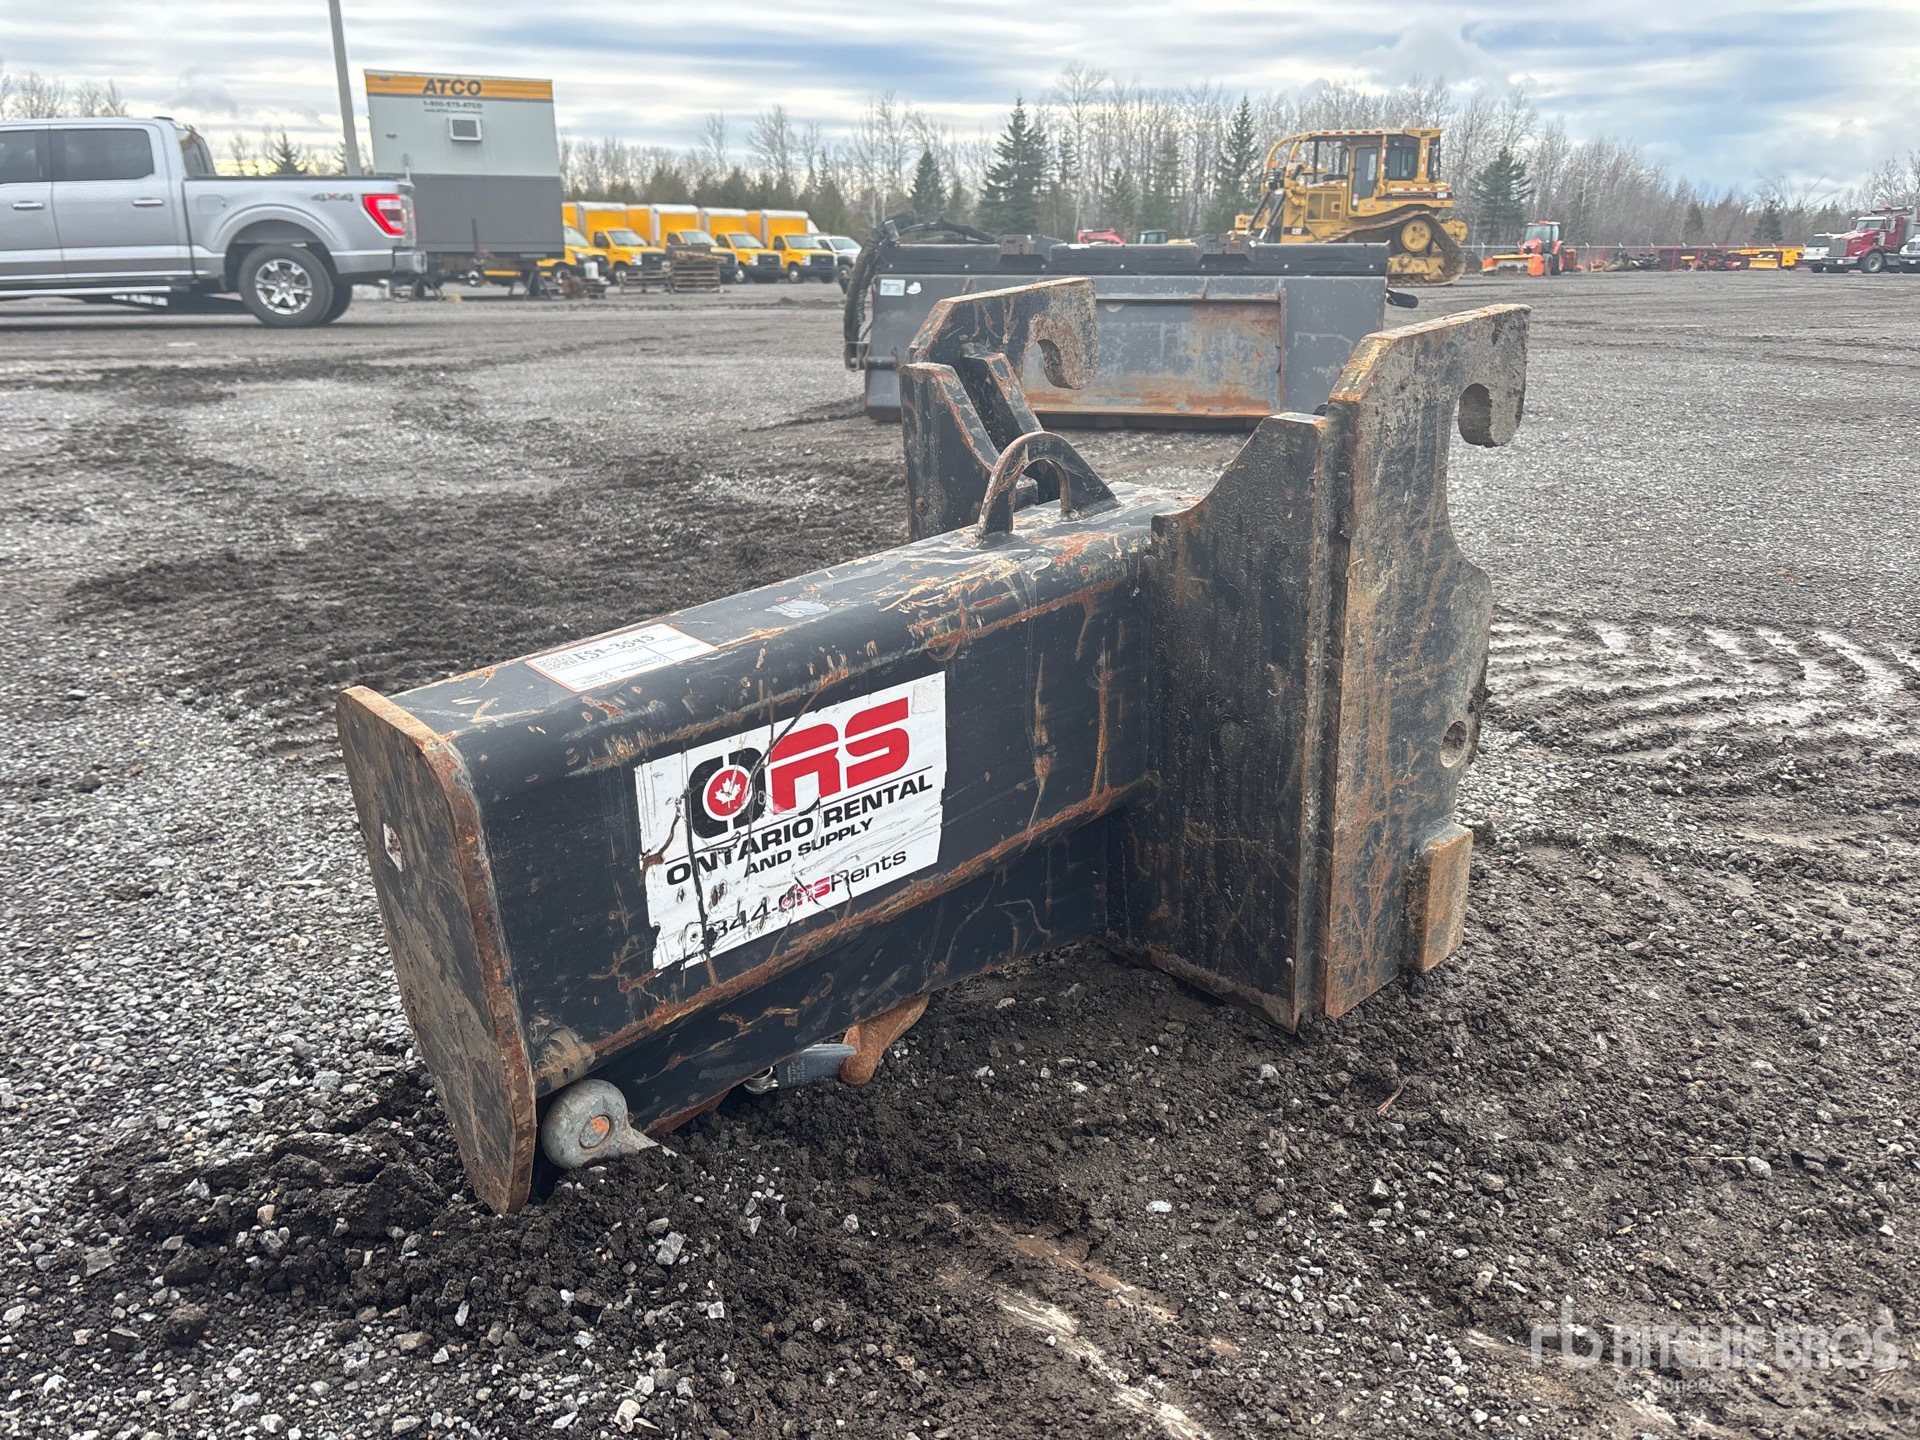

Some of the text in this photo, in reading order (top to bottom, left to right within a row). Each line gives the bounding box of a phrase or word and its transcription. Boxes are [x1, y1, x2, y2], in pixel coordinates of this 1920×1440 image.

[422, 79, 482, 97] ATCO
[689, 697, 909, 839] ORS
[666, 775, 933, 886] ONTARIO RENTAL
[743, 818, 873, 878] AND SUPPLY
